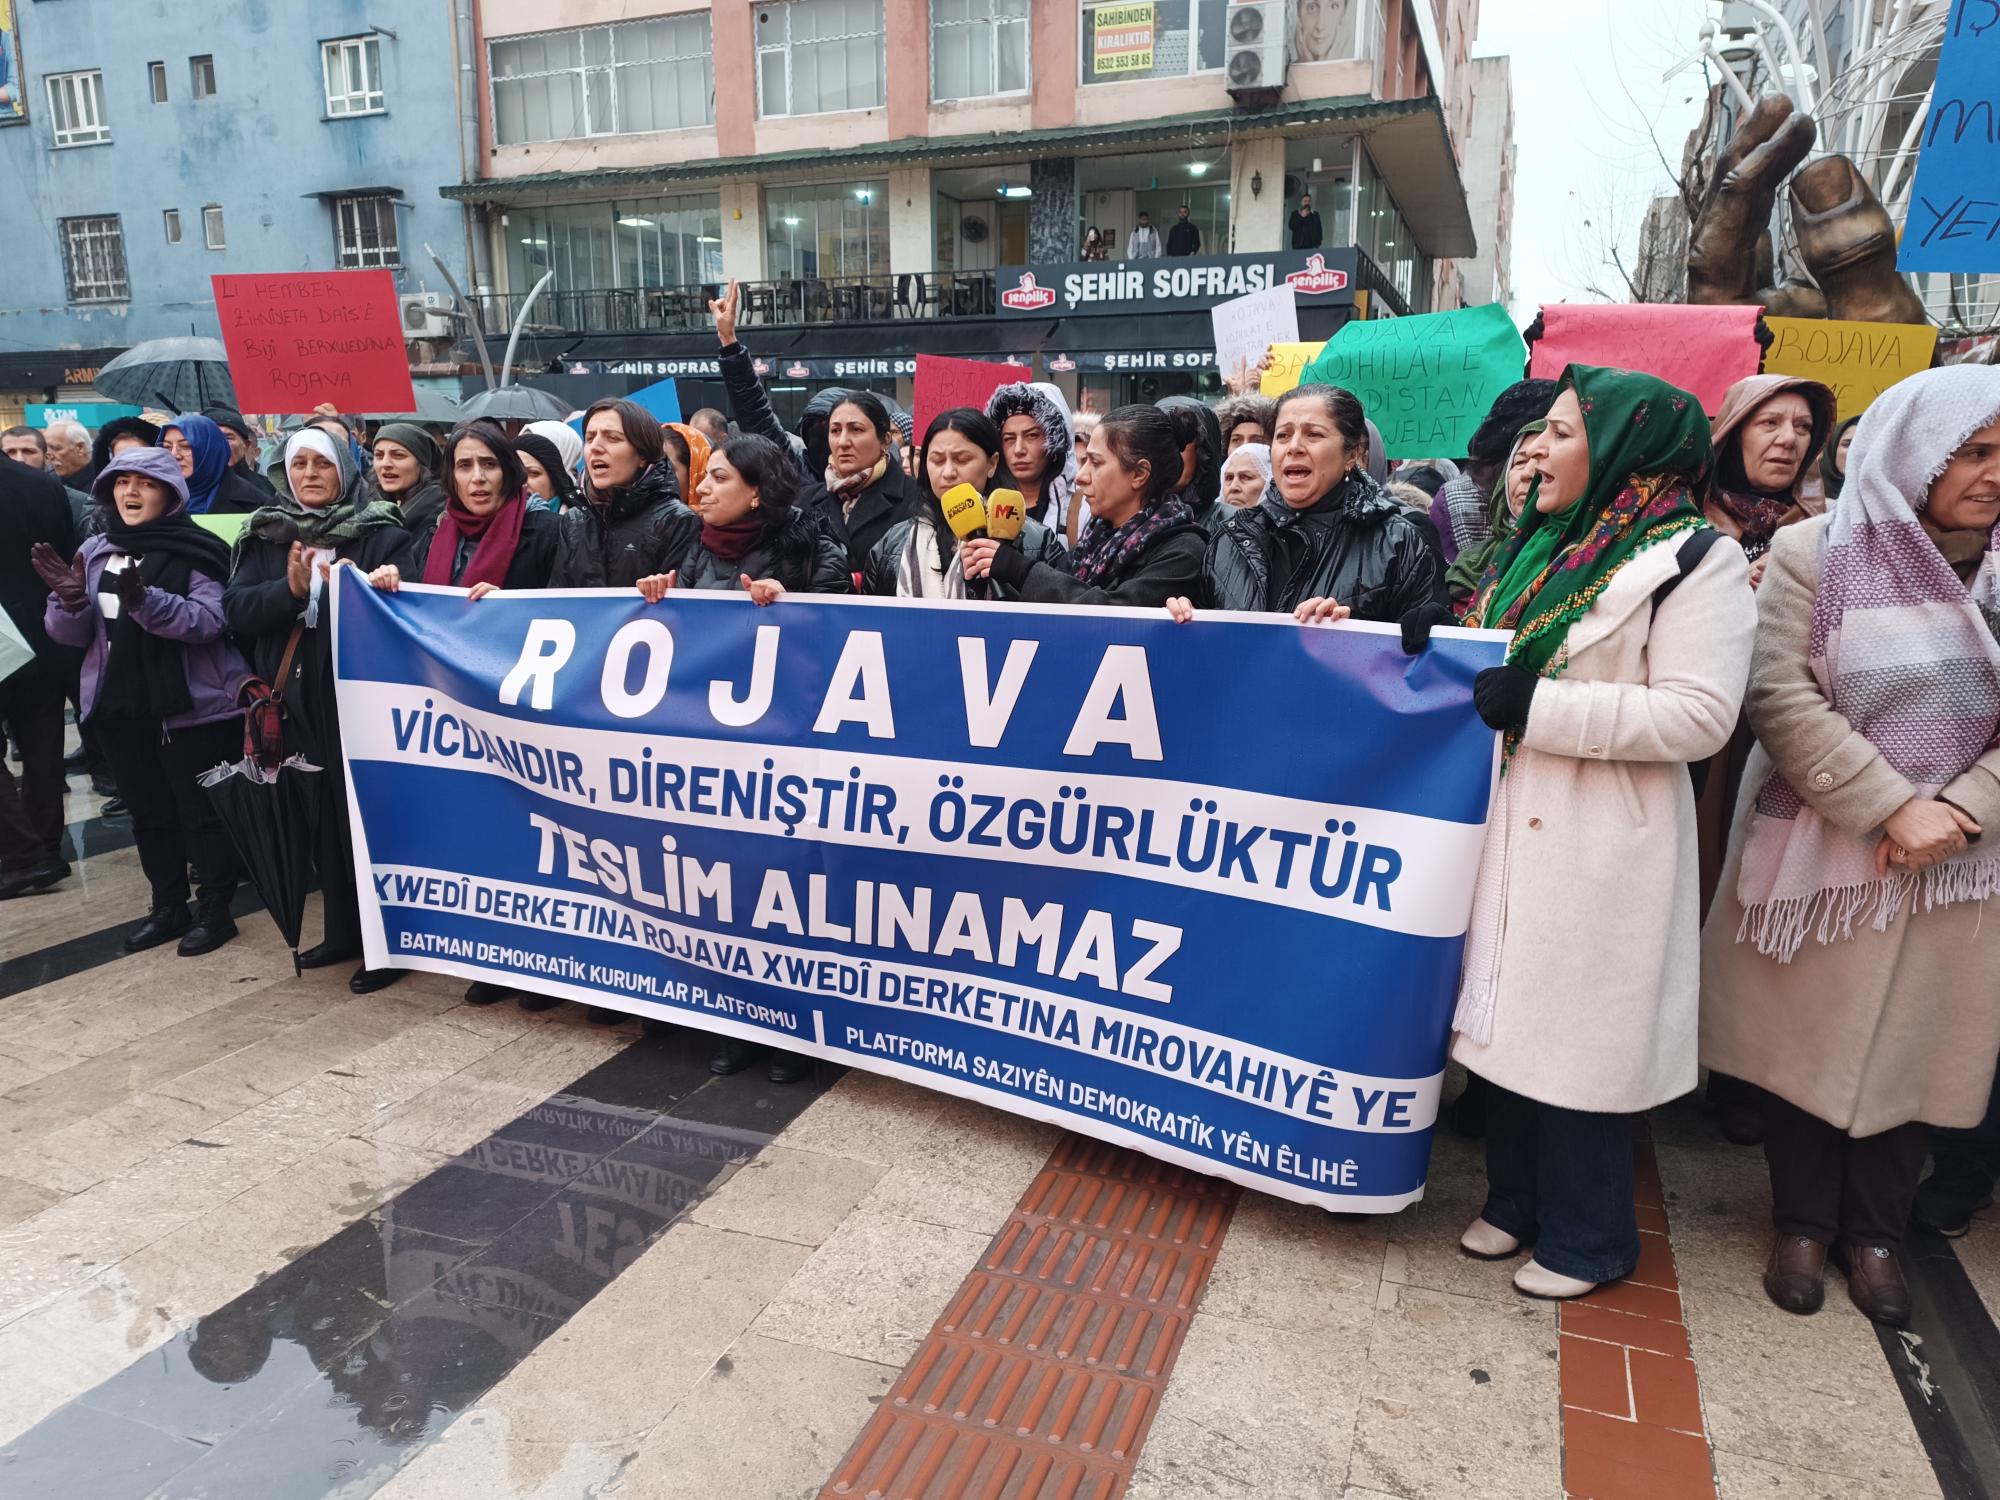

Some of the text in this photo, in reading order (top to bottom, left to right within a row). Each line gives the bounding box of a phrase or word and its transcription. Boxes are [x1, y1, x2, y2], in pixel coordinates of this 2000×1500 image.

[1097, 7, 1152, 27] SAHİBİNDEN
[1098, 31, 1150, 49] KIRALIKTIR
[1097, 57, 1114, 70] 0532
[1116, 55, 1129, 68] 553
[255, 279, 341, 299] HEMBER
[1064, 263, 1275, 310] ŞEHİR SOFRASI
[1327, 315, 1457, 347] OJAVA
[1776, 326, 1902, 369] ROJAVA
[834, 358, 888, 377] ŞEHİR
[1104, 352, 1218, 371] ŞEHİR SOF
[271, 368, 352, 395] ROJAVA
[499, 618, 1164, 762] ROJAVA
[391, 698, 1403, 912] VİCDANDIR, DİRENİŞTİR, ÖZGÜRLÜKTÜR
[530, 812, 1184, 1004] TESLİM ALINAMAZ
[400, 930, 798, 1031] BATMAN DEMOKRATİK KURUMLAR PLATFORMU
[374, 872, 1416, 1128] XWEDÎ DERKETINA ROJAVA XWEDÎ DERKETINA MIROVAHIYÊ YE
[846, 1025, 1360, 1188] PLATFORMA SAZIYÊN DEMOKRATÎK YÊN ÊLIHÊ
